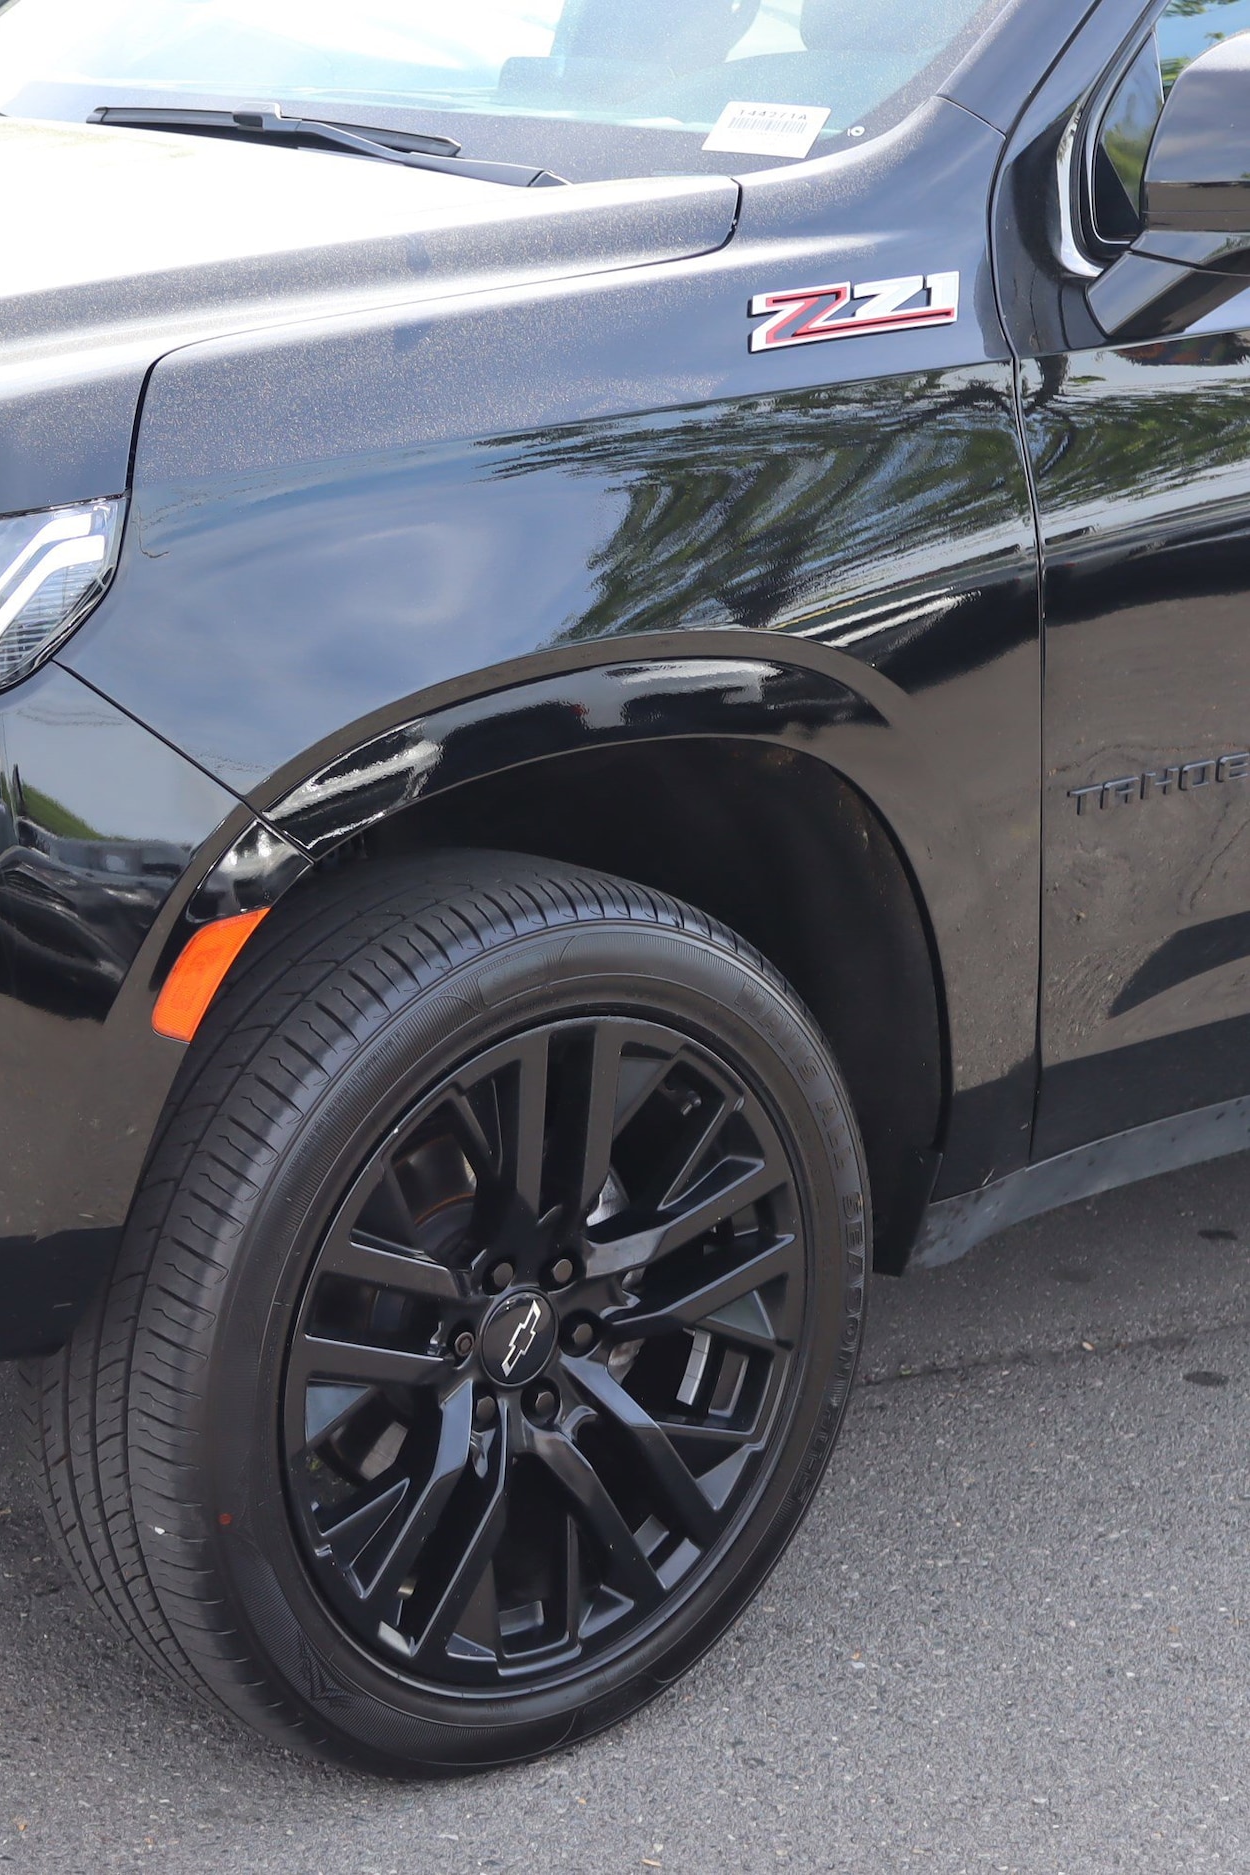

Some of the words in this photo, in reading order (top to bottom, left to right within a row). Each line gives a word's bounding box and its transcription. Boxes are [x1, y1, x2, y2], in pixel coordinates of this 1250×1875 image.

[748, 270, 960, 353] Z71
[1066, 752, 1250, 816] TAHOE
[834, 1191, 863, 1379] SEASON
